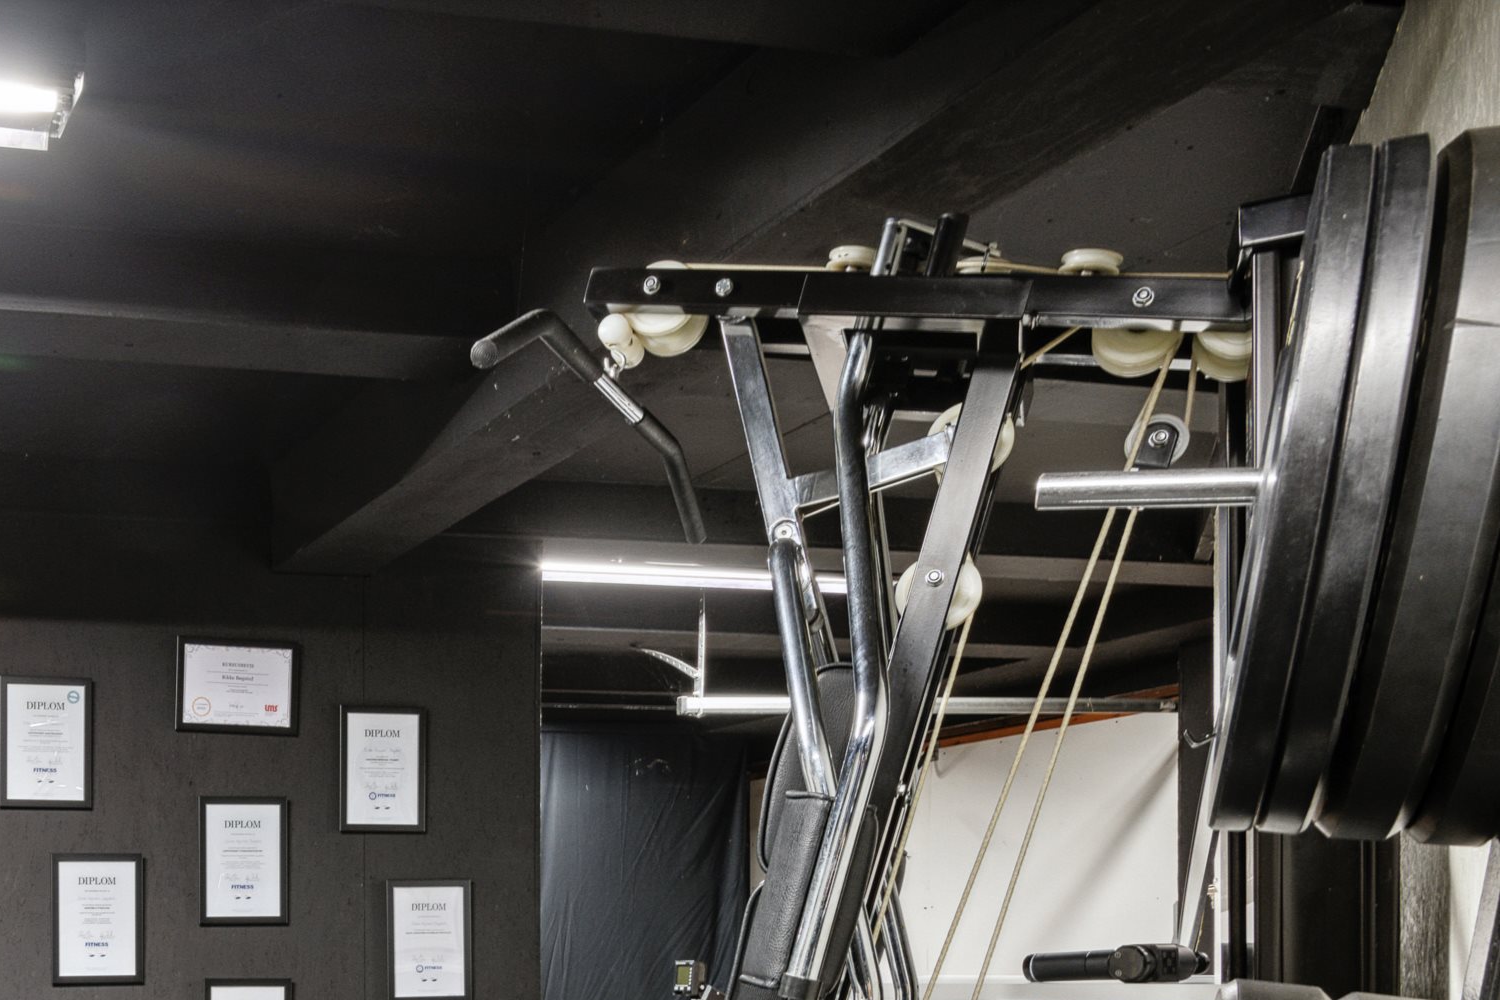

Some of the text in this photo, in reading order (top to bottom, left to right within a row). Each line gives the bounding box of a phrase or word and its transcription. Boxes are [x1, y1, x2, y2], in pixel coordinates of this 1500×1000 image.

[26, 701, 65, 711] DIPLOM
[364, 728, 401, 738] DIPLOM
[224, 820, 261, 829] DIPLOM
[78, 876, 116, 886] DIPLOM
[411, 903, 447, 912] DIPLOM
